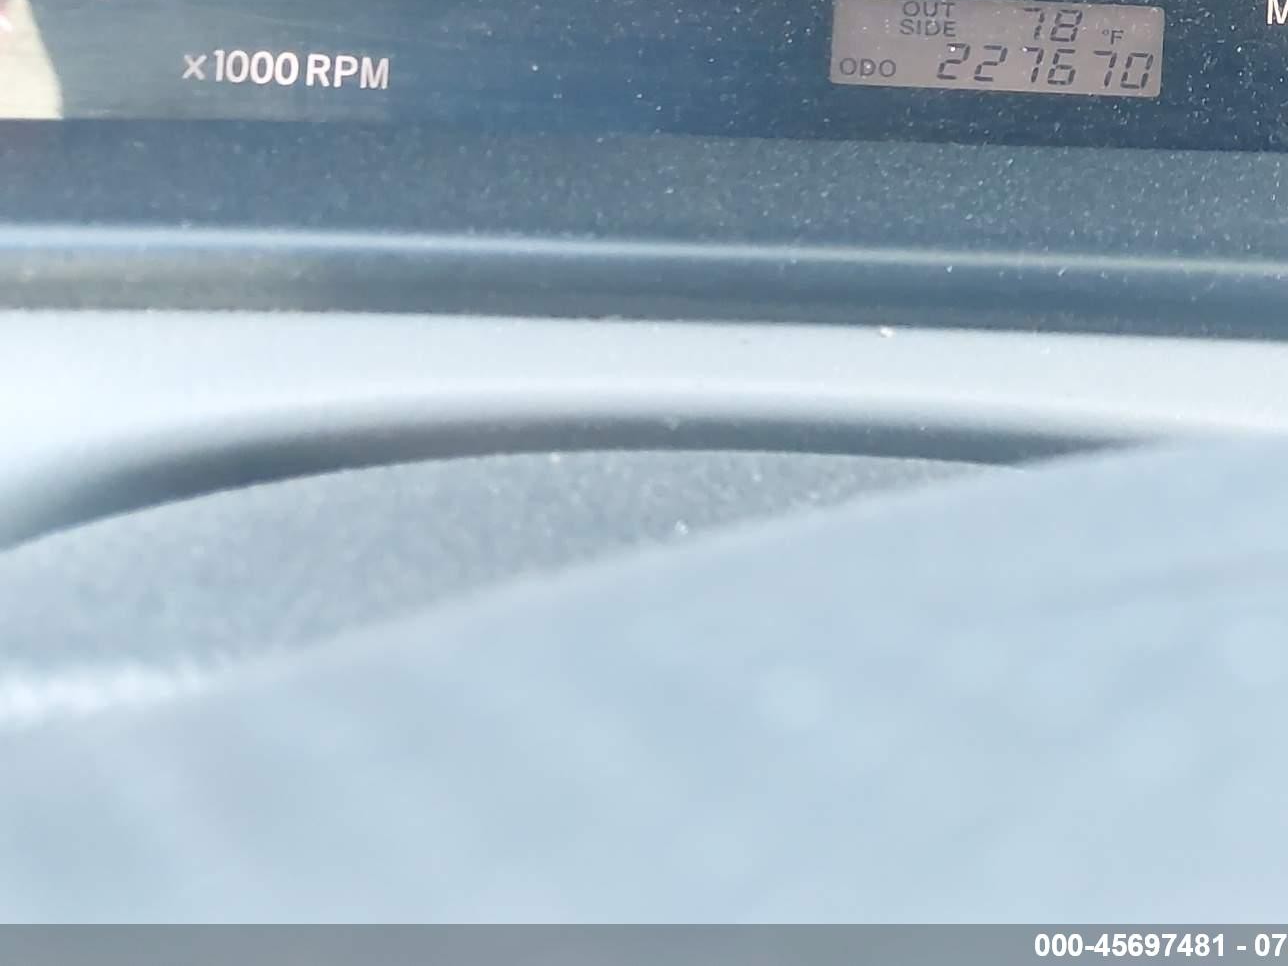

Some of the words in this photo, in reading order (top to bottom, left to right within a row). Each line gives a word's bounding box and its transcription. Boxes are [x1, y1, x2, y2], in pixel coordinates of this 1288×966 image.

[902, 0, 956, 19] OUT
[1023, 6, 1083, 43] 78
[900, 19, 957, 38] SIDE
[306, 53, 389, 90] RPM
[839, 57, 897, 78] ODO
[936, 42, 1154, 90] 227670
